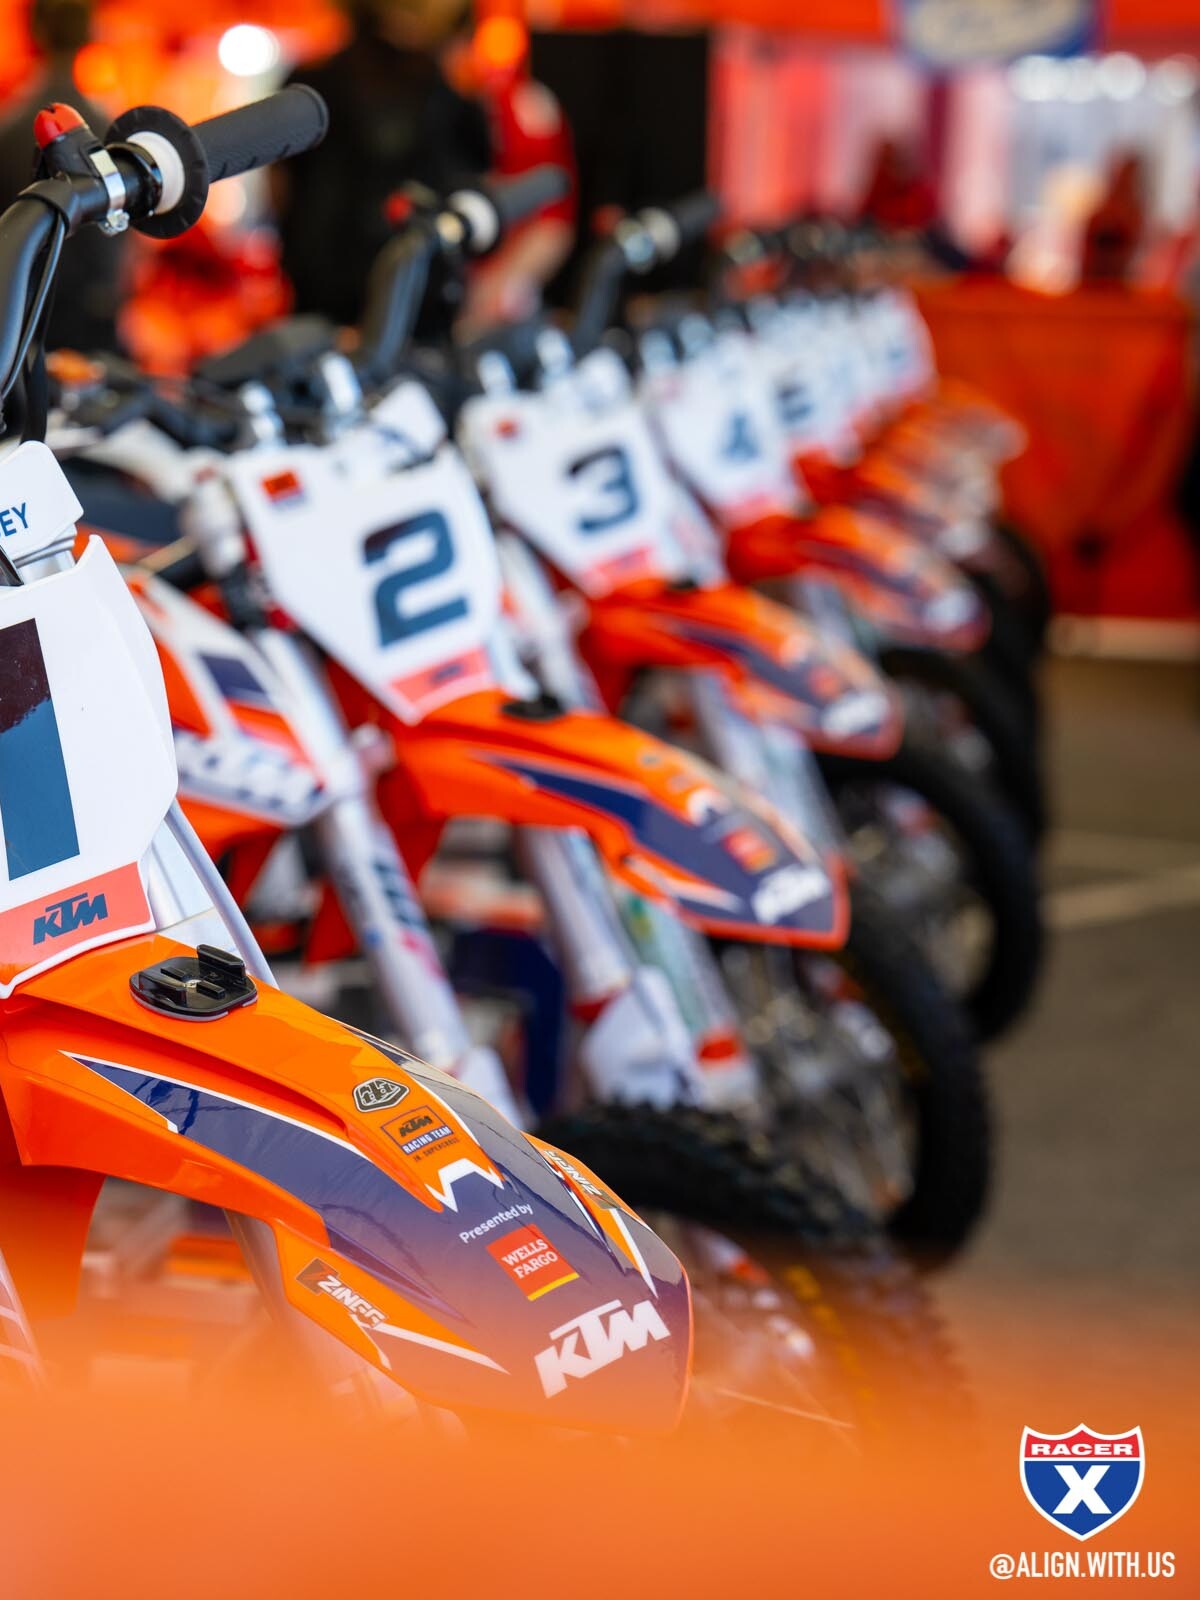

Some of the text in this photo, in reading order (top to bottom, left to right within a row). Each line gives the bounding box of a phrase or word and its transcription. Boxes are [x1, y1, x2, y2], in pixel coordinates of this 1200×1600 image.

[564, 444, 641, 535] 3
[362, 508, 470, 648] 2
[33, 892, 109, 946] KTM
[398, 1114, 434, 1138] KTM
[402, 1126, 452, 1155] RACING TEAM
[458, 1202, 534, 1244] Presented by
[501, 1238, 549, 1267] WELLS
[513, 1250, 558, 1280] FARGO
[533, 1298, 672, 1399] KTM
